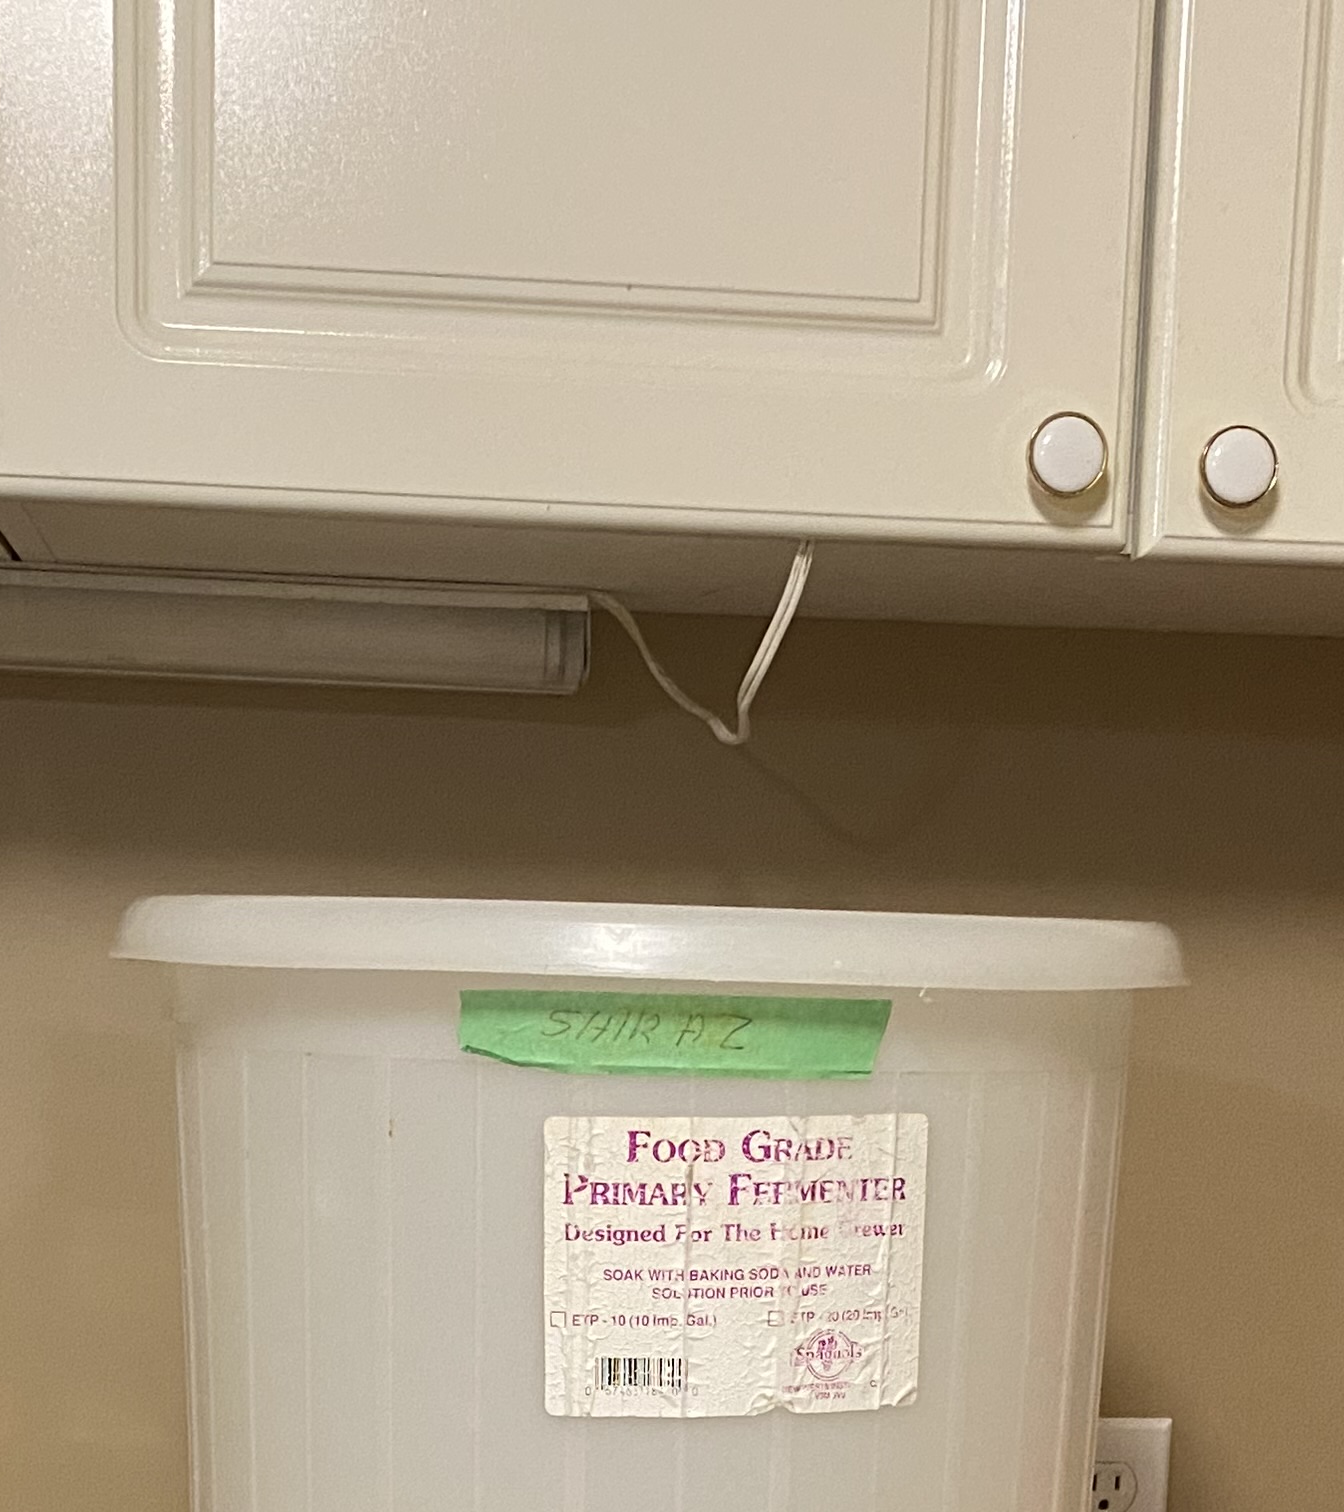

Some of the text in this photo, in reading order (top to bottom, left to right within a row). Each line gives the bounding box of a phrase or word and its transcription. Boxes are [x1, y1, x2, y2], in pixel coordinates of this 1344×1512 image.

[626, 1129, 853, 1163] FOOD GRADE
[562, 1172, 713, 1206] PRIMARY
[564, 1223, 666, 1246] Designed
[675, 1223, 713, 1242] For
[722, 1222, 762, 1242] The
[603, 1268, 644, 1281] SOAK
[648, 1269, 685, 1281] WITH
[689, 1268, 745, 1281] BAKING
[794, 1265, 822, 1279] AND
[825, 1263, 872, 1278] WATER
[652, 1286, 726, 1299] SOLTION
[729, 1286, 774, 1299] PRIOR
[801, 1283, 828, 1297] USE
[611, 1314, 627, 1327] 10
[629, 1313, 650, 1329] (10
